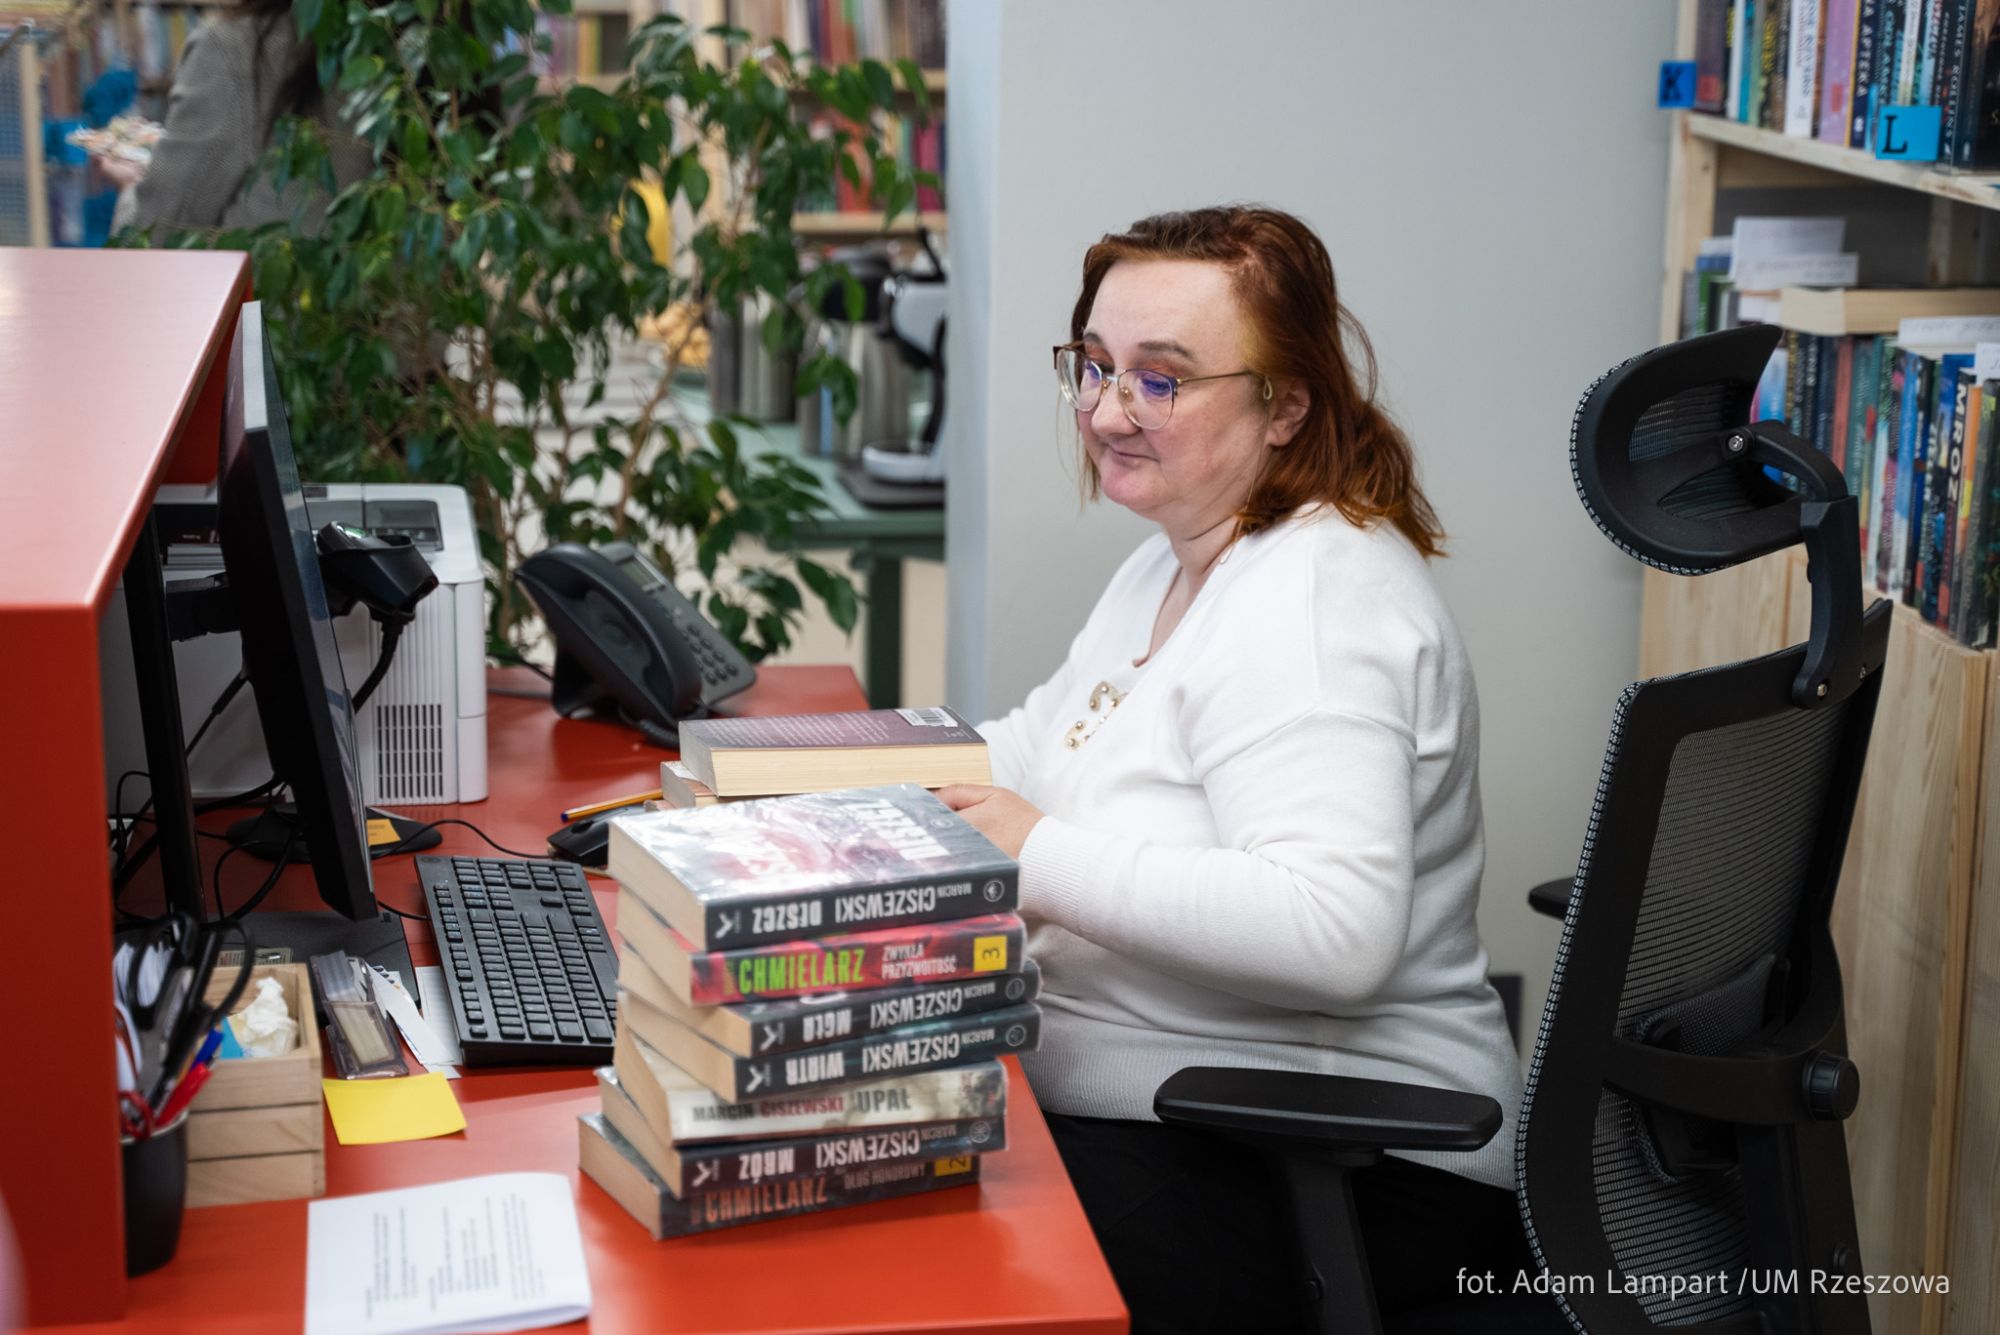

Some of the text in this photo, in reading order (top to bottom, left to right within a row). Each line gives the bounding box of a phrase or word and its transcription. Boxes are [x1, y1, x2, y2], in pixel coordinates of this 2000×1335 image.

[1856, 23, 1873, 97] APTEKA
[1945, 4, 1967, 138] JAMES ROLLINS
[1663, 62, 1685, 103] K
[1882, 115, 1907, 154] L
[835, 886, 936, 923] CISZEWSKI
[936, 882, 972, 898] MARCIN
[752, 901, 822, 934] DESZCZ
[739, 948, 866, 994] CHMIELARZ
[881, 956, 956, 980] PRZYZWOITOŚĆ
[882, 943, 924, 961] ZWYKŁA
[982, 946, 1001, 960] 3
[802, 982, 996, 1042] MARCIN CISZEWSKI MGŁA
[785, 1025, 996, 1087] MARCIN CISZEWSKI WIATR
[692, 1089, 912, 1122] MARCIN CISZEWSKI UPAŁ
[739, 1124, 957, 1183] MARCIN CISZEWSKI MRÓZ
[705, 1177, 828, 1222] CHMIELARZ
